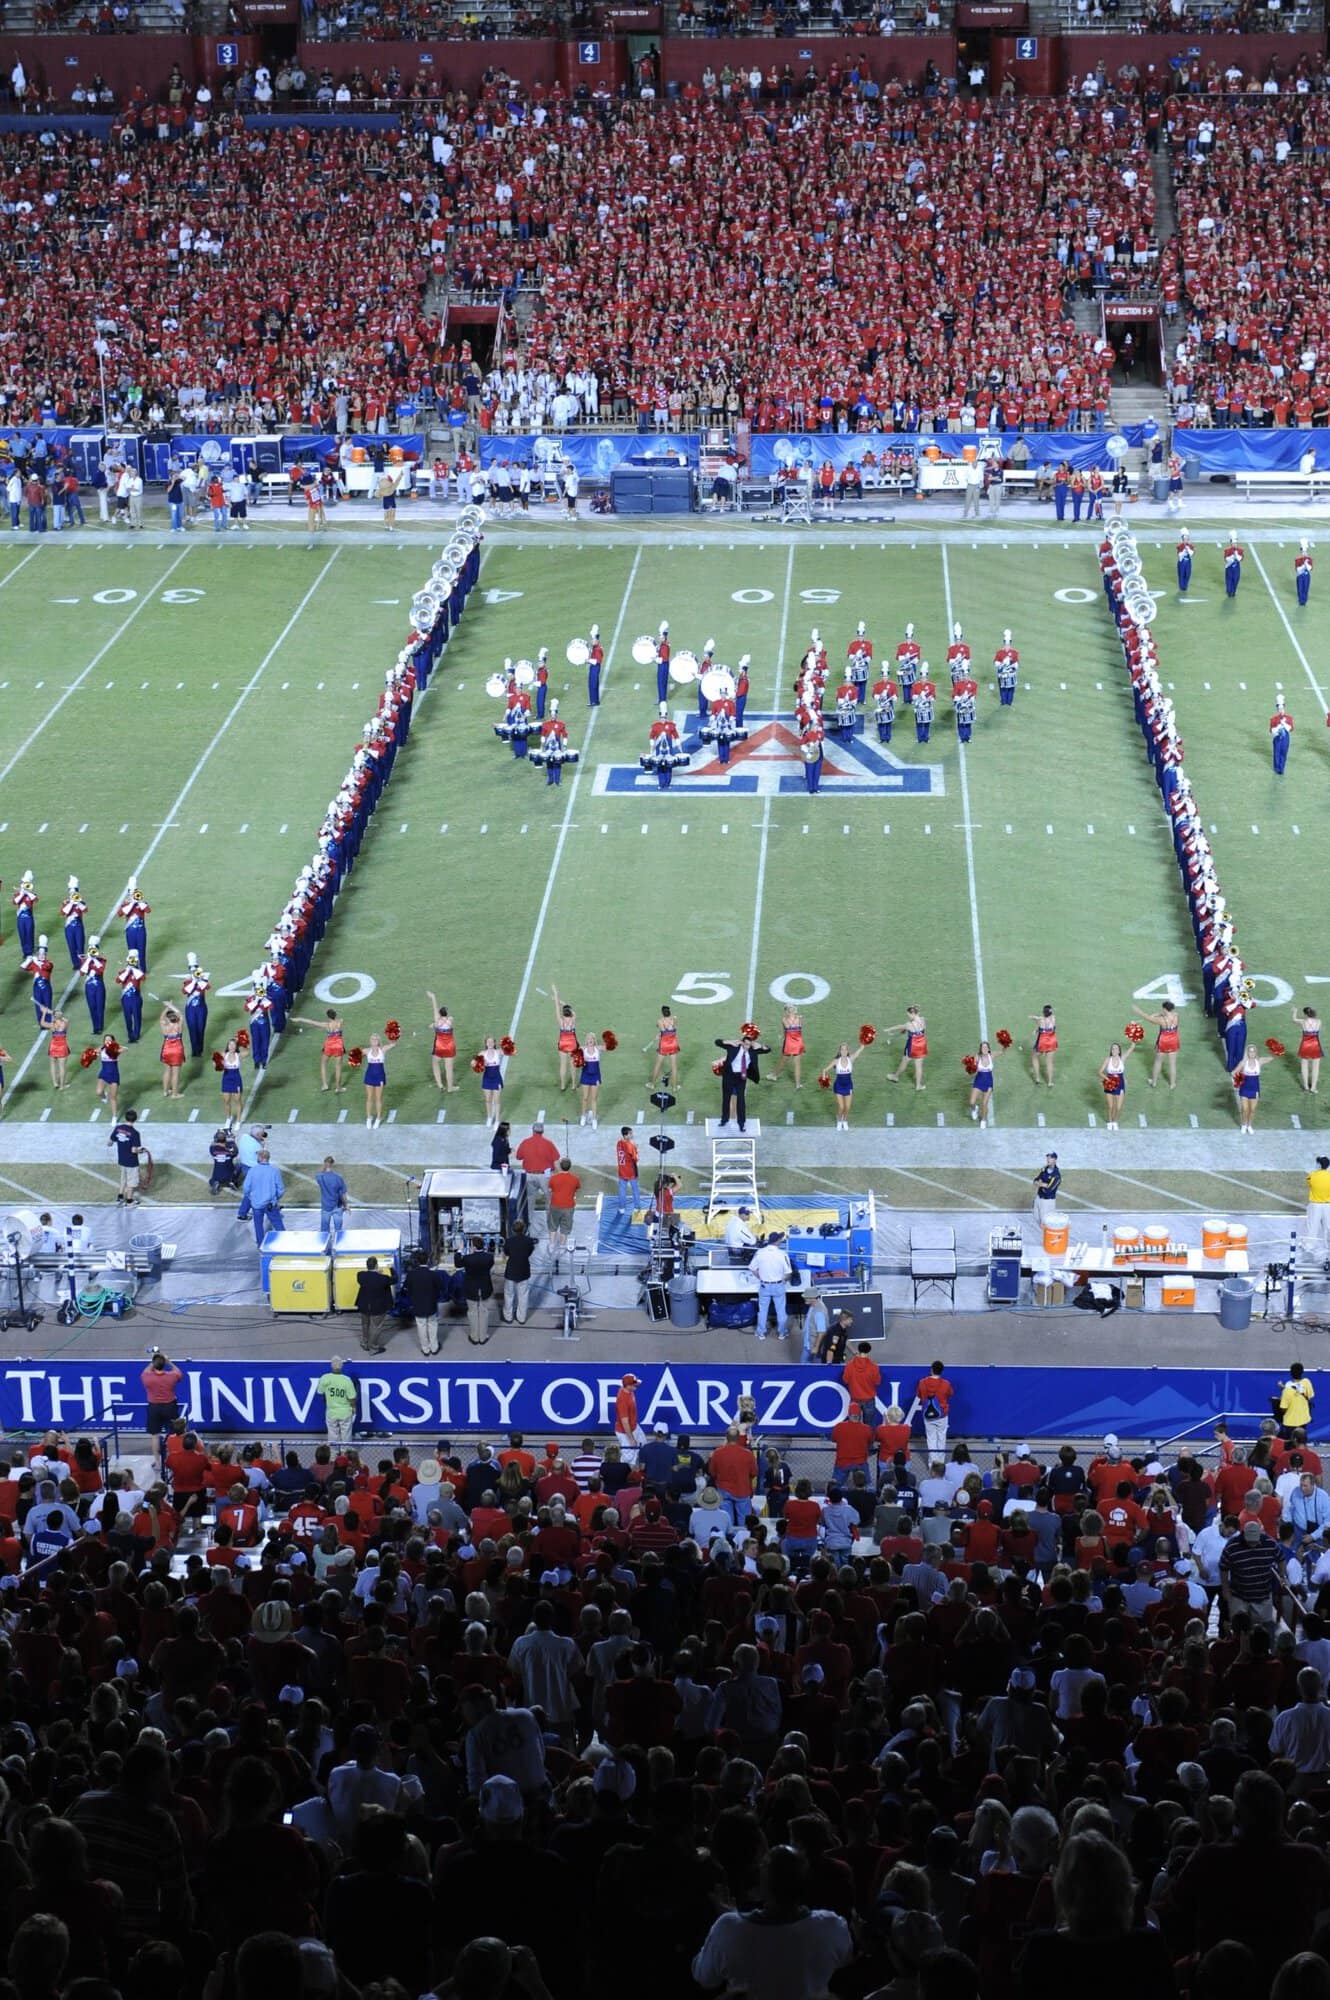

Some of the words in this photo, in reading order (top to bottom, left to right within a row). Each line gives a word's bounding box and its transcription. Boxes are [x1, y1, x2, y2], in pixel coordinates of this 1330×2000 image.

[222, 45, 232, 58] 3
[584, 44, 594, 57] 4
[1024, 39, 1032, 53] 4
[1118, 307, 1141, 315] SECTION
[181, 1371, 525, 1425] NIVRSITY
[233, 1508, 245, 1531] 7
[293, 1516, 319, 1536] 45
